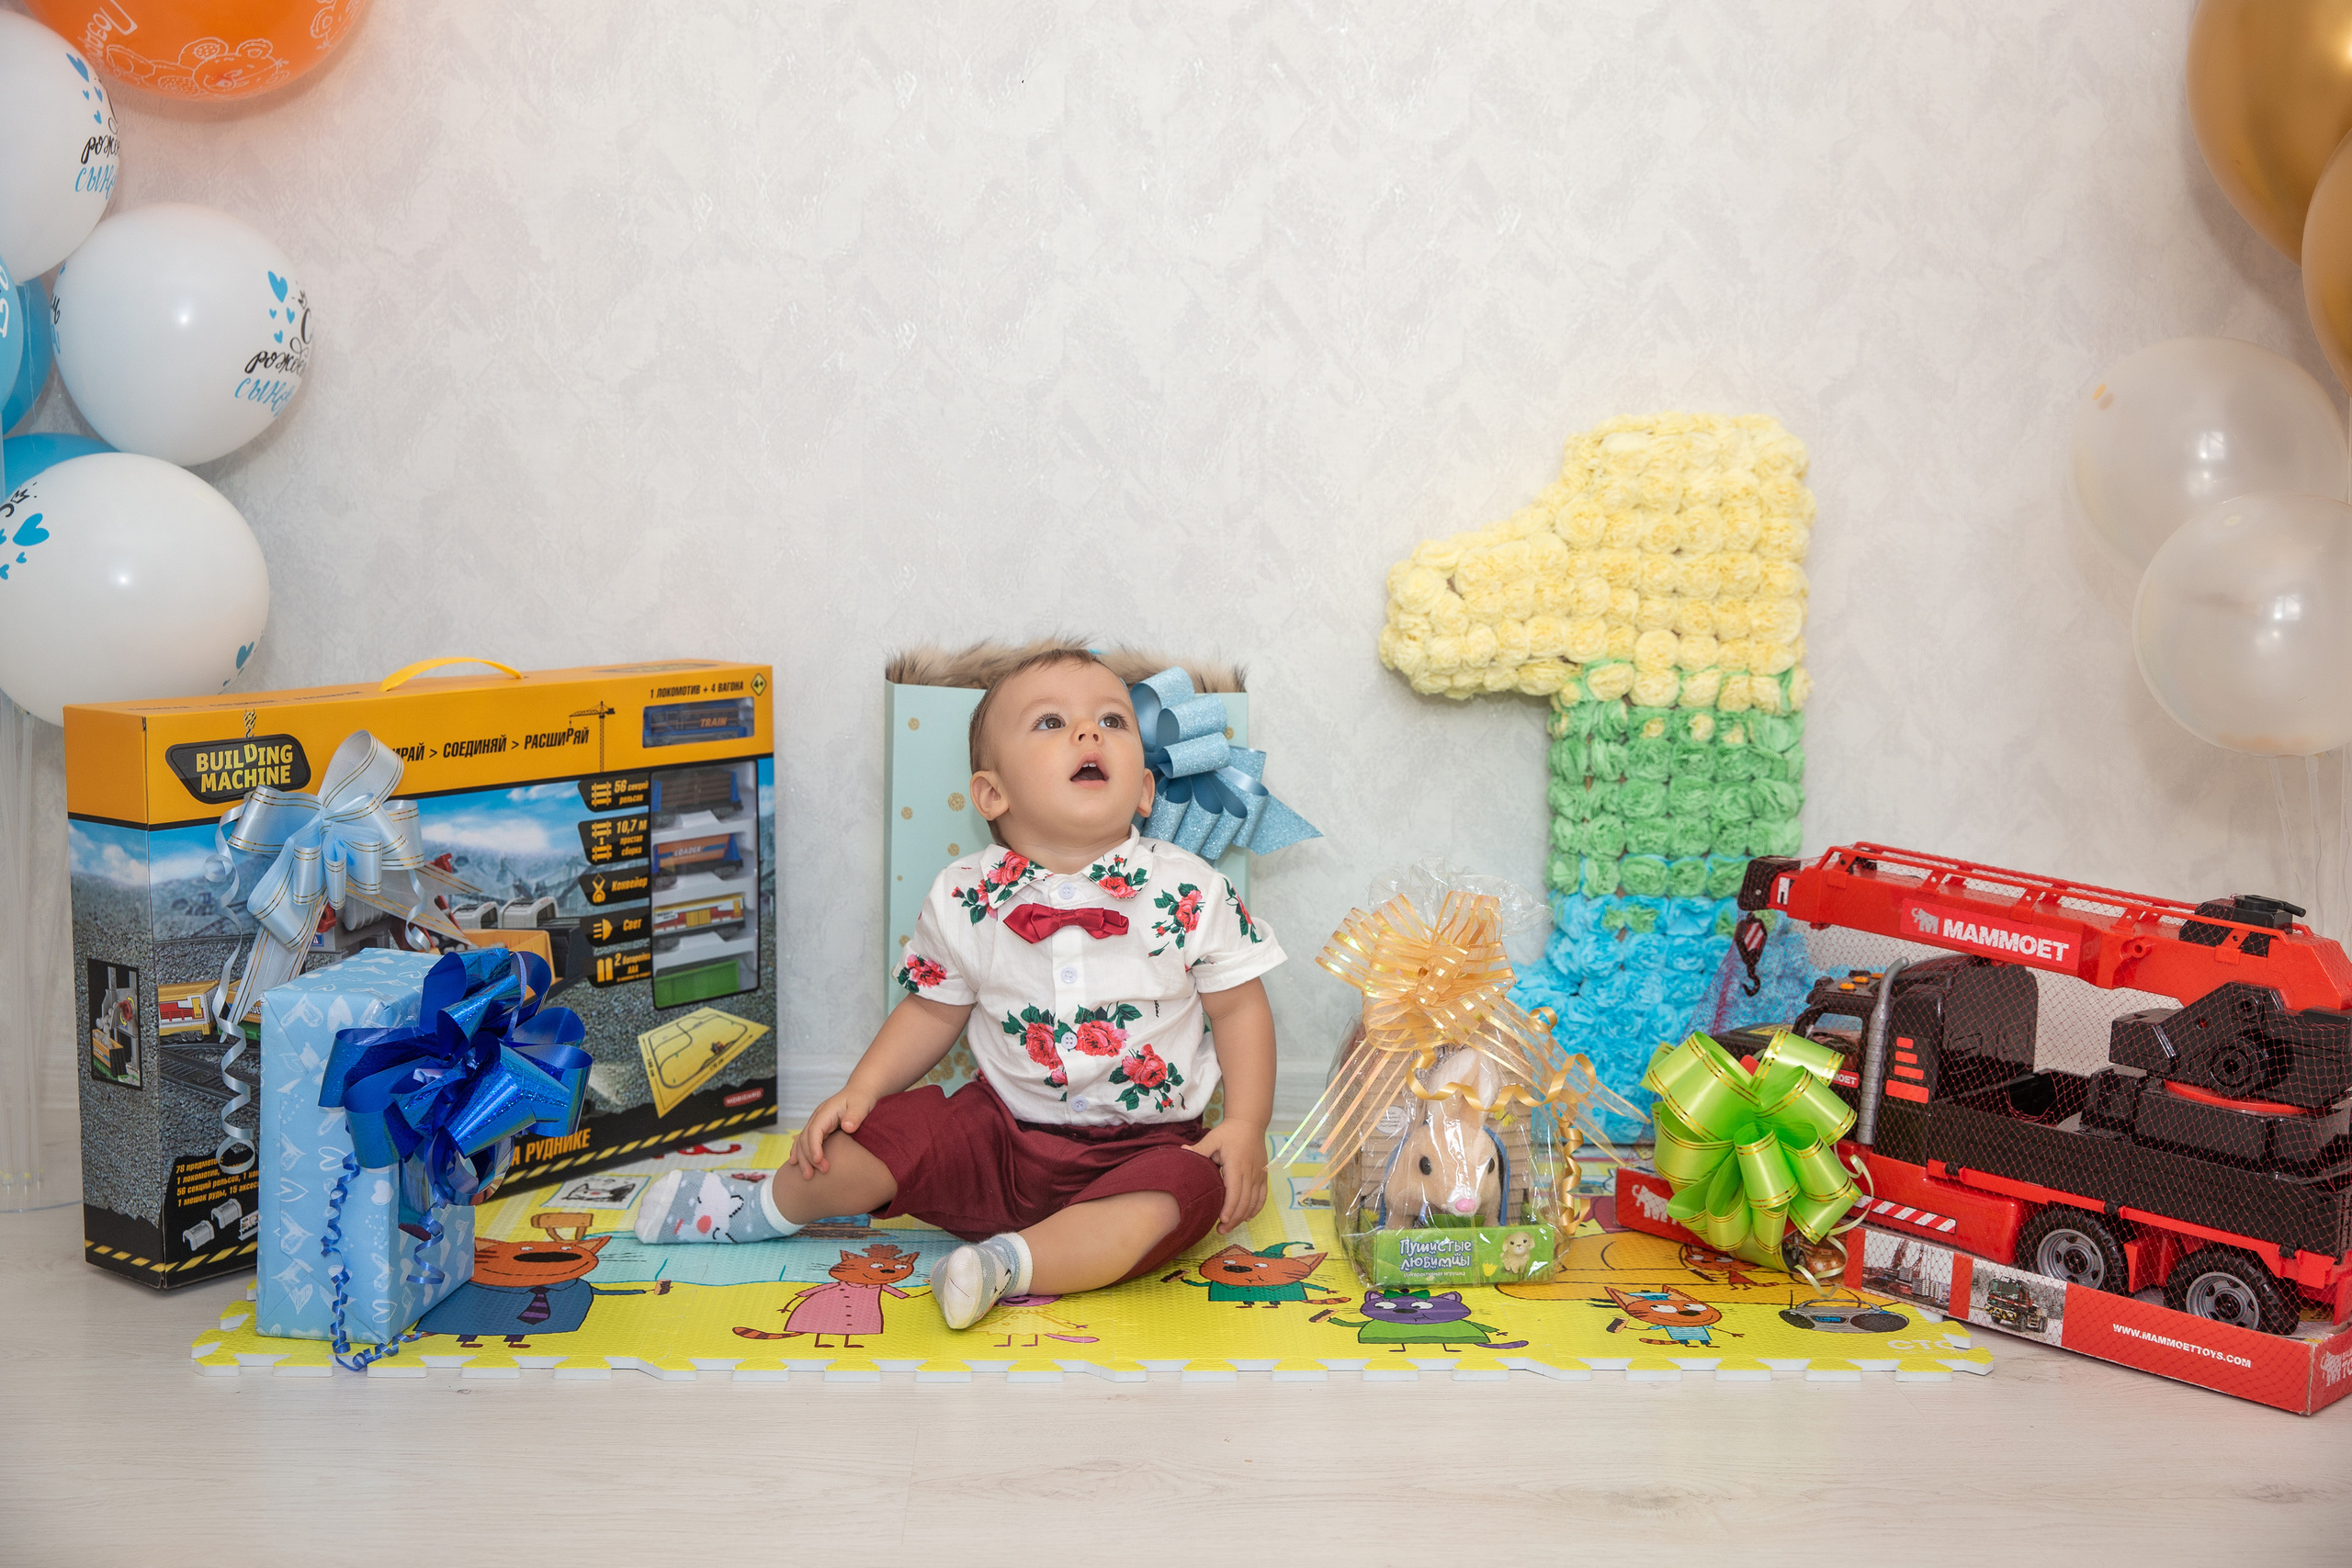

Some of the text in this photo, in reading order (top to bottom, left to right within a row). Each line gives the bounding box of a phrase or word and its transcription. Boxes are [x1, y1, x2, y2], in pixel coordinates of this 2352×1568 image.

[650, 689, 654, 698] 1
[656, 685, 701, 698] ЛОКОМОТИВ
[711, 683, 716, 692] 4
[718, 681, 744, 693] ВАГОНА
[753, 680, 764, 688] 4+
[700, 716, 728, 728] TRAIN
[443, 734, 507, 758] СОЕДИНЯЙ
[524, 727, 590, 750] РАСШИРЯЙ
[196, 743, 293, 773] BUILDING
[200, 764, 291, 793] MACHINE
[614, 779, 628, 794] 56
[616, 818, 638, 834] 10,7
[673, 845, 702, 856] LOADER
[611, 876, 649, 892] Конвейер
[622, 919, 642, 931] Свет
[1942, 918, 2069, 962] MAMMOET
[614, 952, 622, 966] 2
[1834, 1074, 1857, 1085] OET
[525, 1128, 592, 1163] РУДНИКЕ
[175, 1164, 186, 1174] 78
[186, 1156, 224, 1171] предмето:
[176, 1168, 220, 1185] 1 локомотив,
[176, 1187, 187, 1196] 56
[187, 1180, 212, 1194] секций
[212, 1175, 241, 1189] рельсов,
[177, 1199, 182, 1207] 1
[184, 1193, 208, 1206] мешок
[208, 1189, 228, 1201] руды,
[229, 1185, 238, 1194] 15
[1399, 1238, 1472, 1258] Пушистые
[2112, 1323, 2252, 1369] WWW.MAMMOETTOYS.COM
